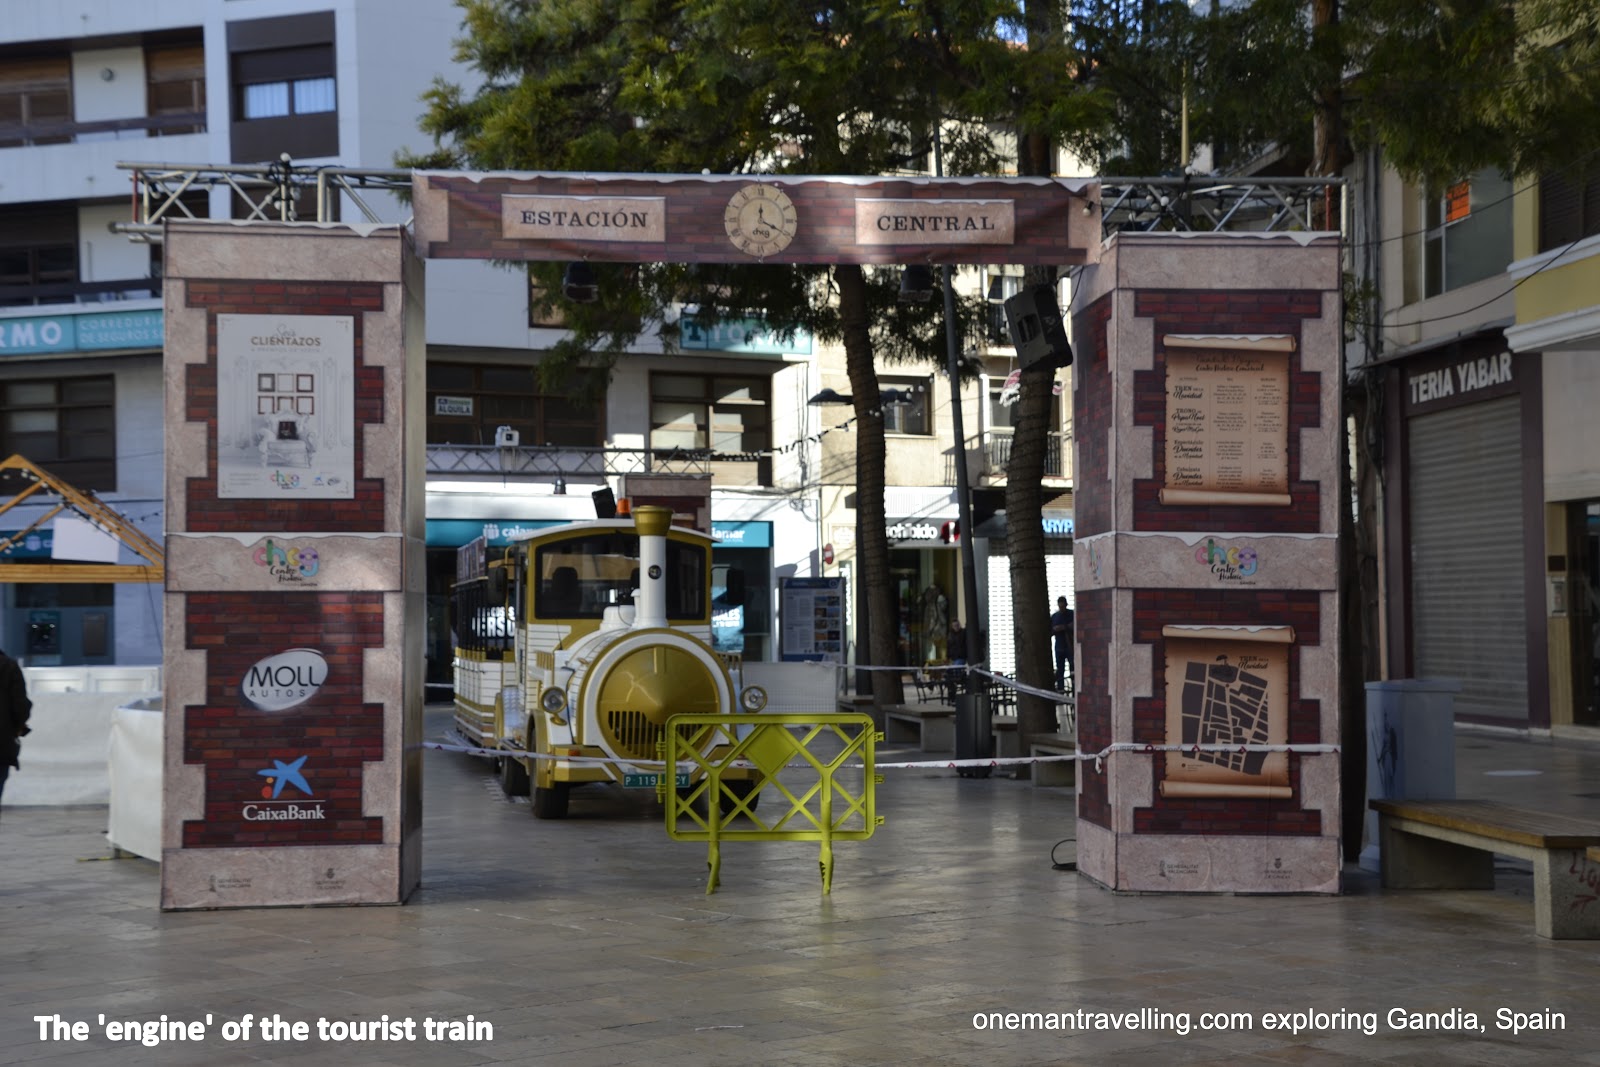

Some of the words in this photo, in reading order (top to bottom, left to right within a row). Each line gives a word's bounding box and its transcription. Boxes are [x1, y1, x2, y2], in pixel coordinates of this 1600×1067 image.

[520, 208, 648, 228] ESTACIÓN
[876, 215, 995, 231] CENTRAL
[250, 336, 321, 347] CLIENTAZOS
[1409, 367, 1455, 404] TERIA
[1457, 352, 1513, 393] YABAR
[1173, 391, 1203, 400] Navidad
[253, 539, 319, 577] chcg
[1195, 539, 1257, 576] chcg
[1238, 661, 1268, 670] Navidad
[250, 666, 320, 687] MOLL
[250, 689, 306, 698] AUTOS
[242, 804, 326, 821] CaixaBank
